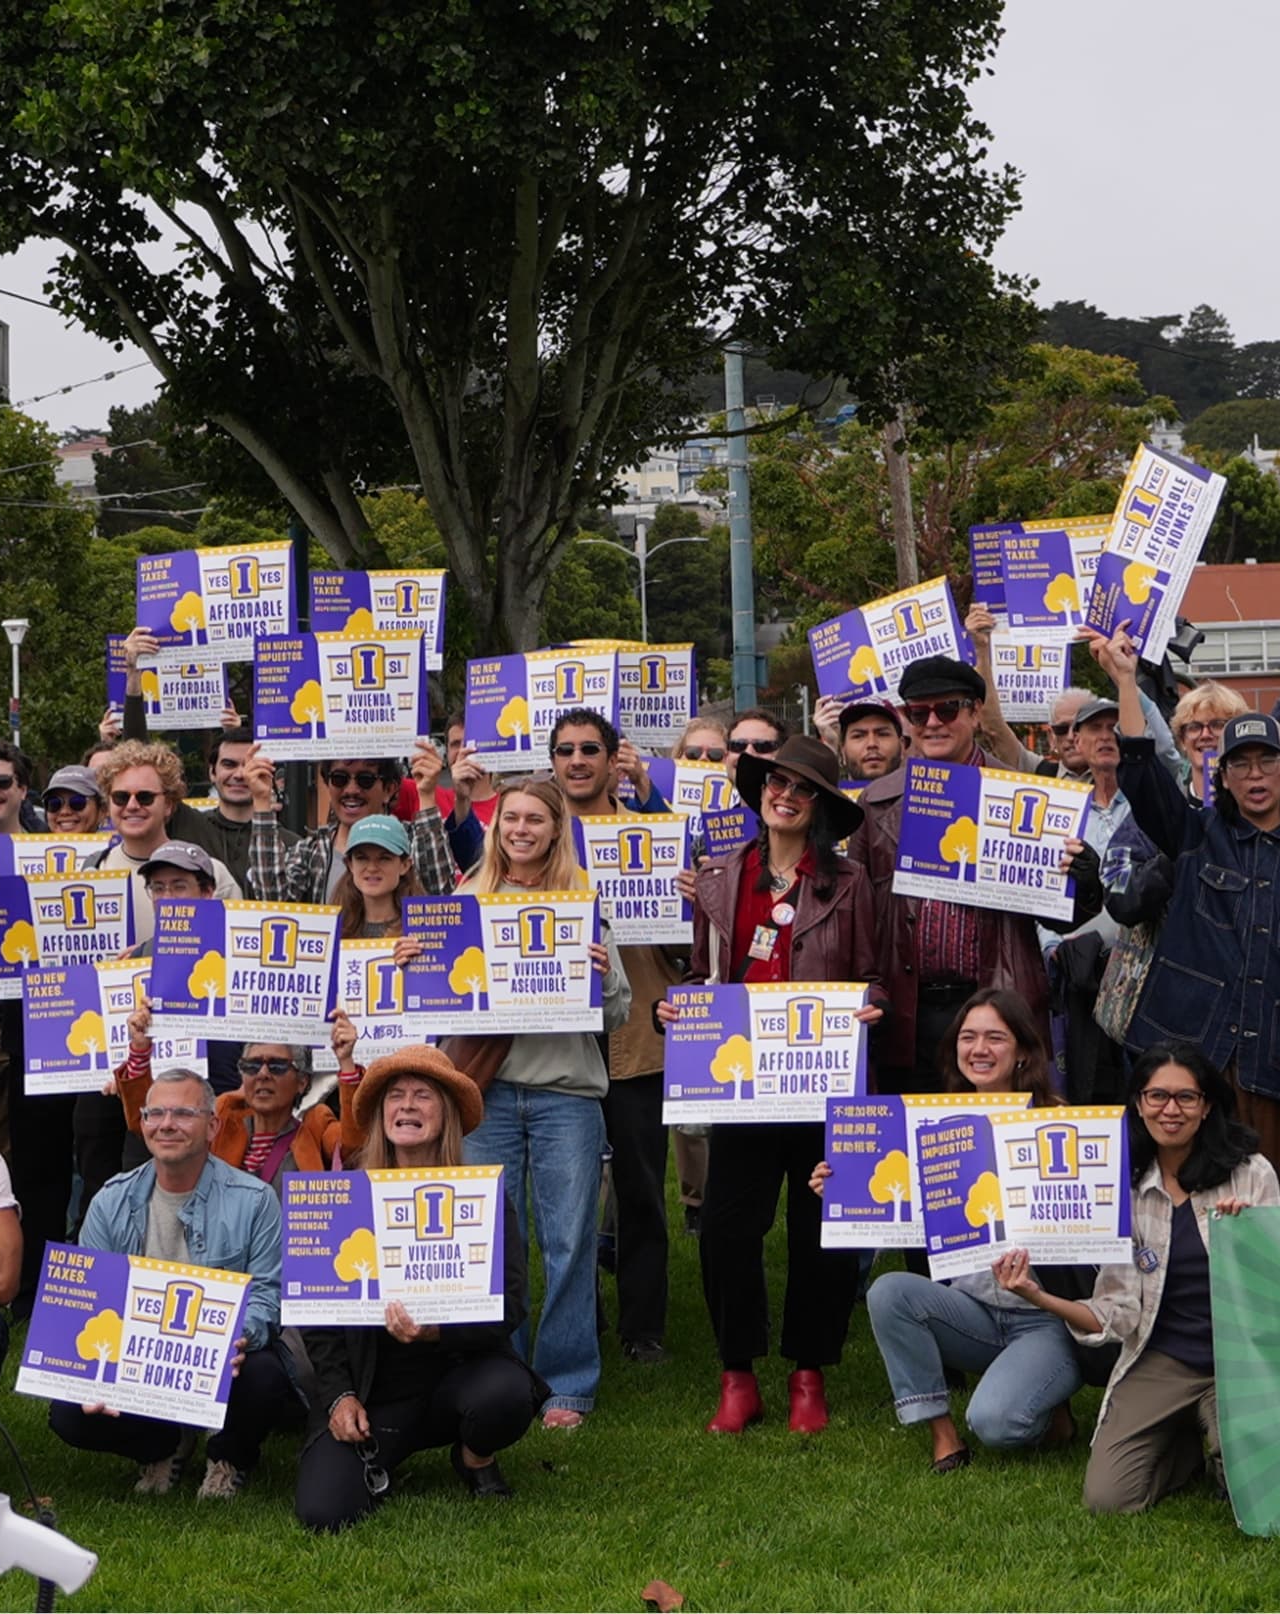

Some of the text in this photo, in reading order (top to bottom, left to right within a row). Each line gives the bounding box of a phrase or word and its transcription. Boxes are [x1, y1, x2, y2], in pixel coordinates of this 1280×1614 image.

[1121, 523, 1138, 549] YES
[1144, 465, 1160, 491] YES
[1143, 475, 1187, 562] AFFORDABLE
[913, 764, 950, 781] NO NEW
[912, 778, 945, 795] TAXES.
[987, 804, 1011, 820] YES
[1045, 813, 1068, 829] YES
[982, 838, 1065, 868] AFFORDABLE
[999, 864, 1044, 888] HOMES
[288, 1179, 351, 1192] SIN NUEVOS
[1033, 1183, 1088, 1202] VIVIENDA
[288, 1193, 352, 1204] IMPUESTOS.
[1030, 1202, 1092, 1222] ASEQUIBLE
[52, 1248, 95, 1269] NO NEW
[408, 1244, 461, 1261] VIVIENDA
[48, 1264, 89, 1284] TAXES.
[405, 1262, 464, 1281] ASEQUIBLE
[135, 1297, 162, 1315] YES
[200, 1309, 226, 1327] YES
[125, 1335, 219, 1370] AFFORDABLE
[142, 1363, 195, 1391] HOMES
